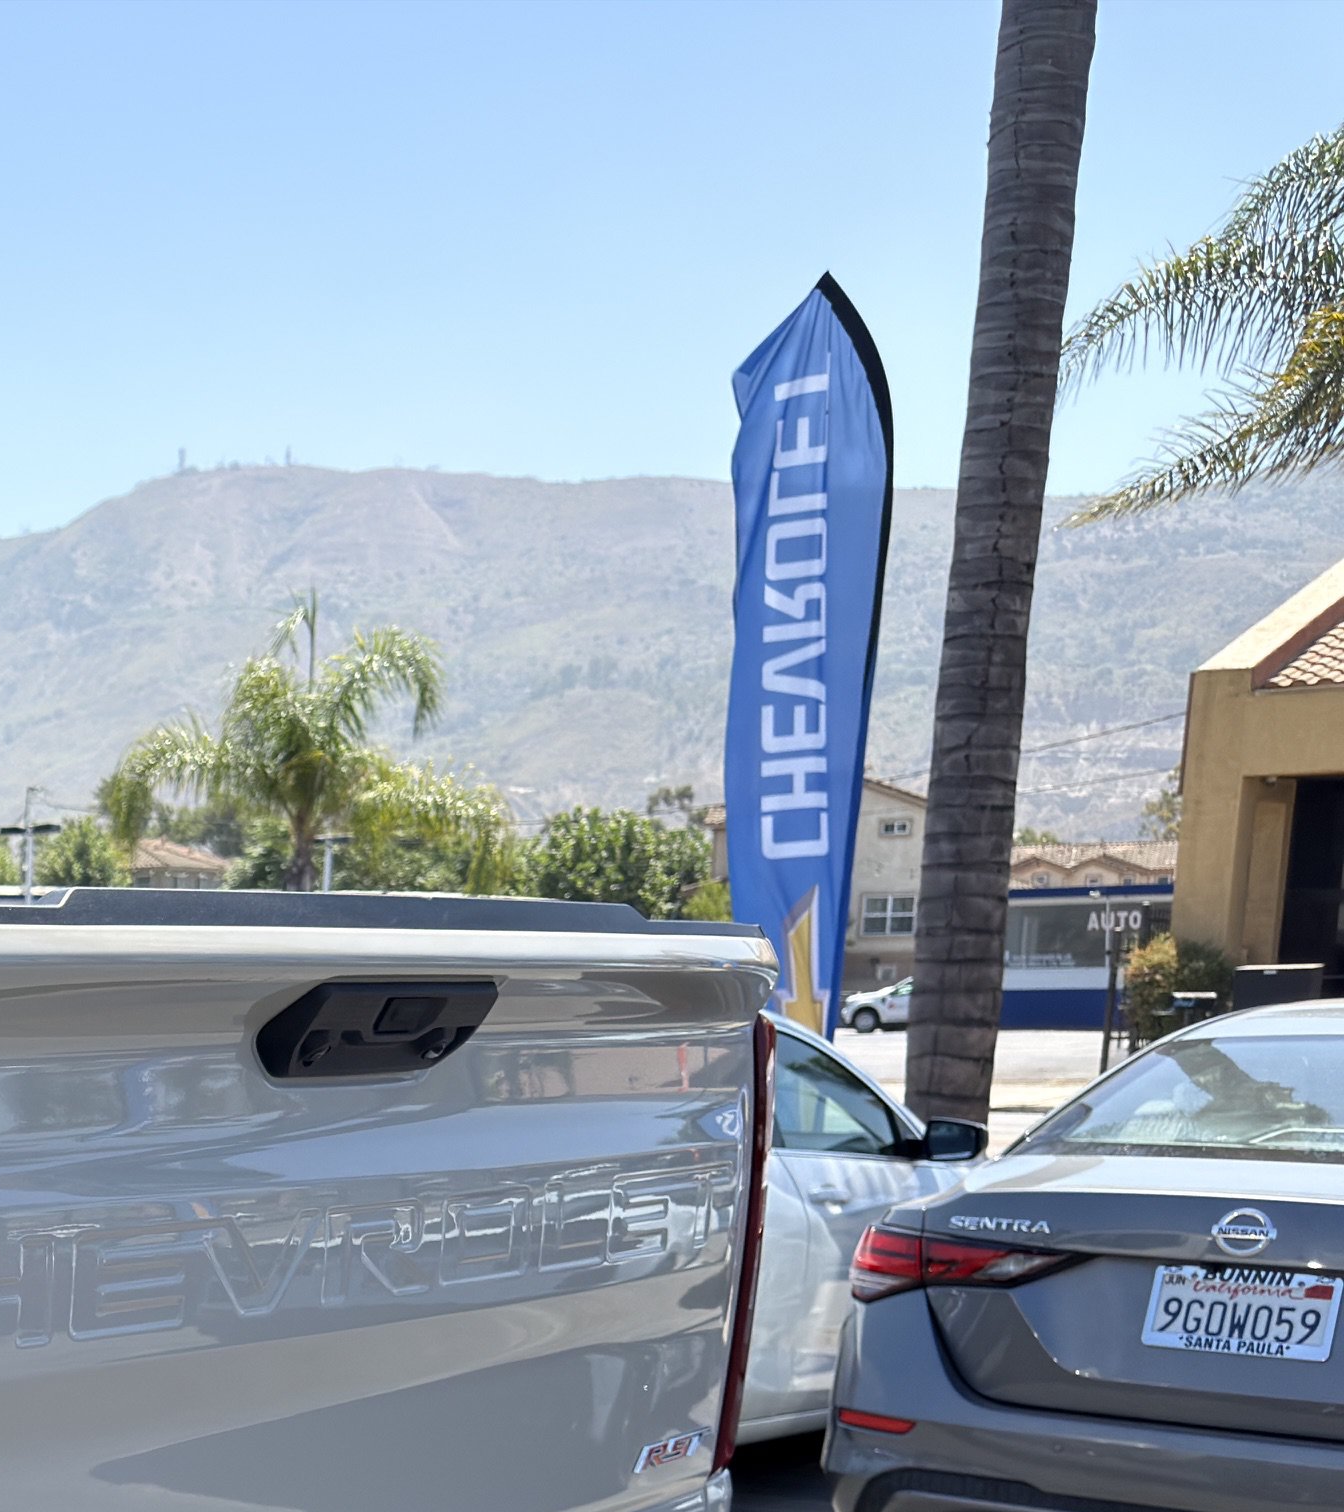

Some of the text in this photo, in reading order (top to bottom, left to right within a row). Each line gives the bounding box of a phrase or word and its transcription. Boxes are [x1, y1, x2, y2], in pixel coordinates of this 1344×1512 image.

[1087, 910, 1142, 932] AUTO
[948, 1215, 1051, 1234] SENTRA
[1216, 1226, 1270, 1238] NISSAN
[1202, 1267, 1294, 1287] BUNNIN
